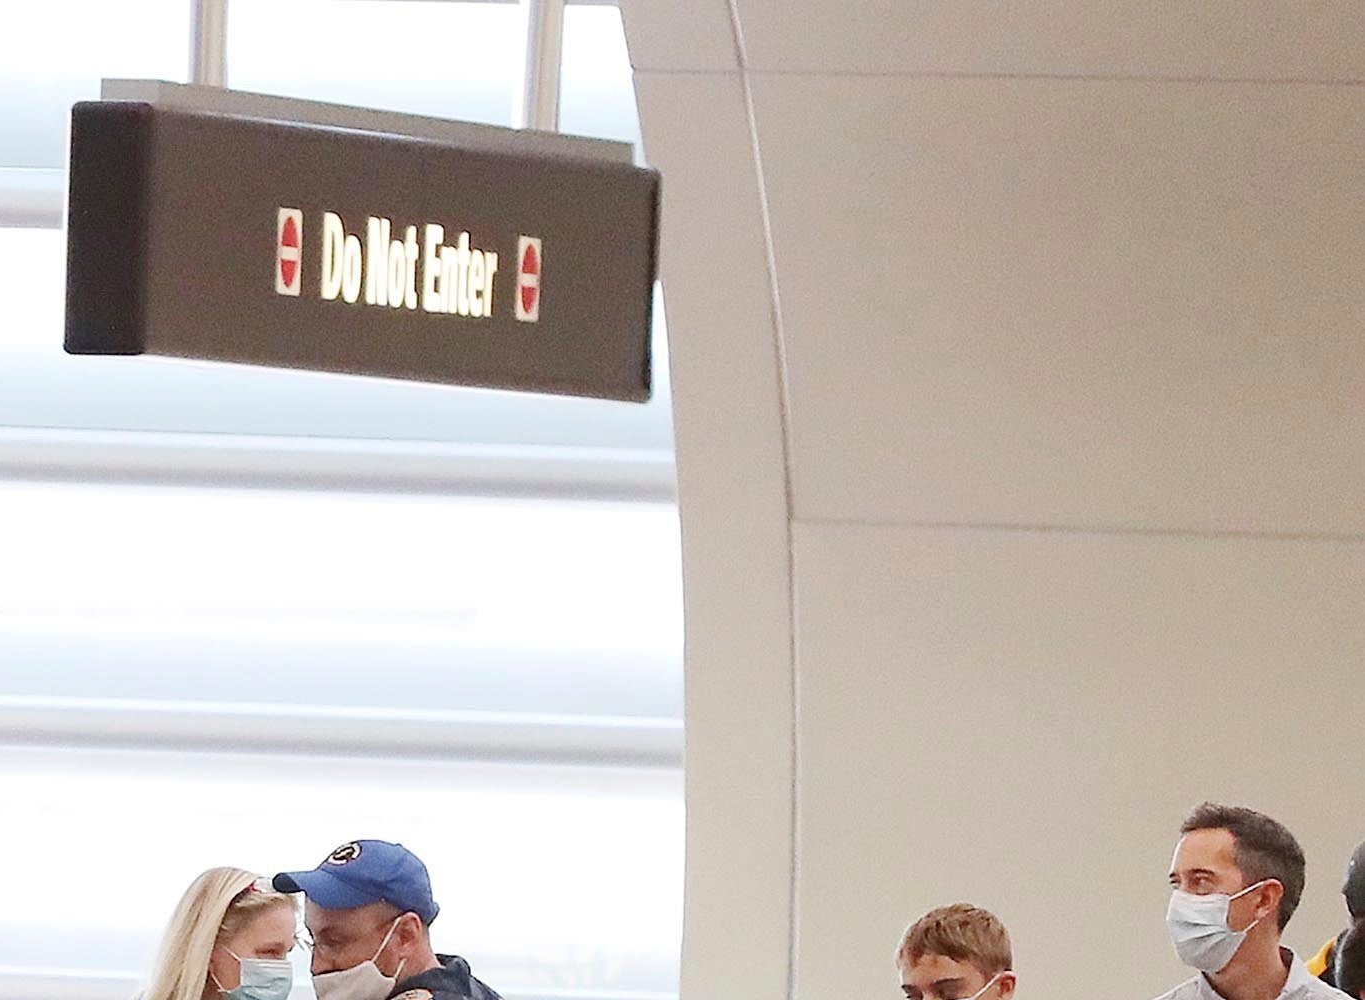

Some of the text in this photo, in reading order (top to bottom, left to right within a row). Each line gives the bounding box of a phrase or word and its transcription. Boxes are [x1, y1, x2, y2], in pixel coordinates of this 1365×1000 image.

[321, 210, 499, 318] Do Not Enter
